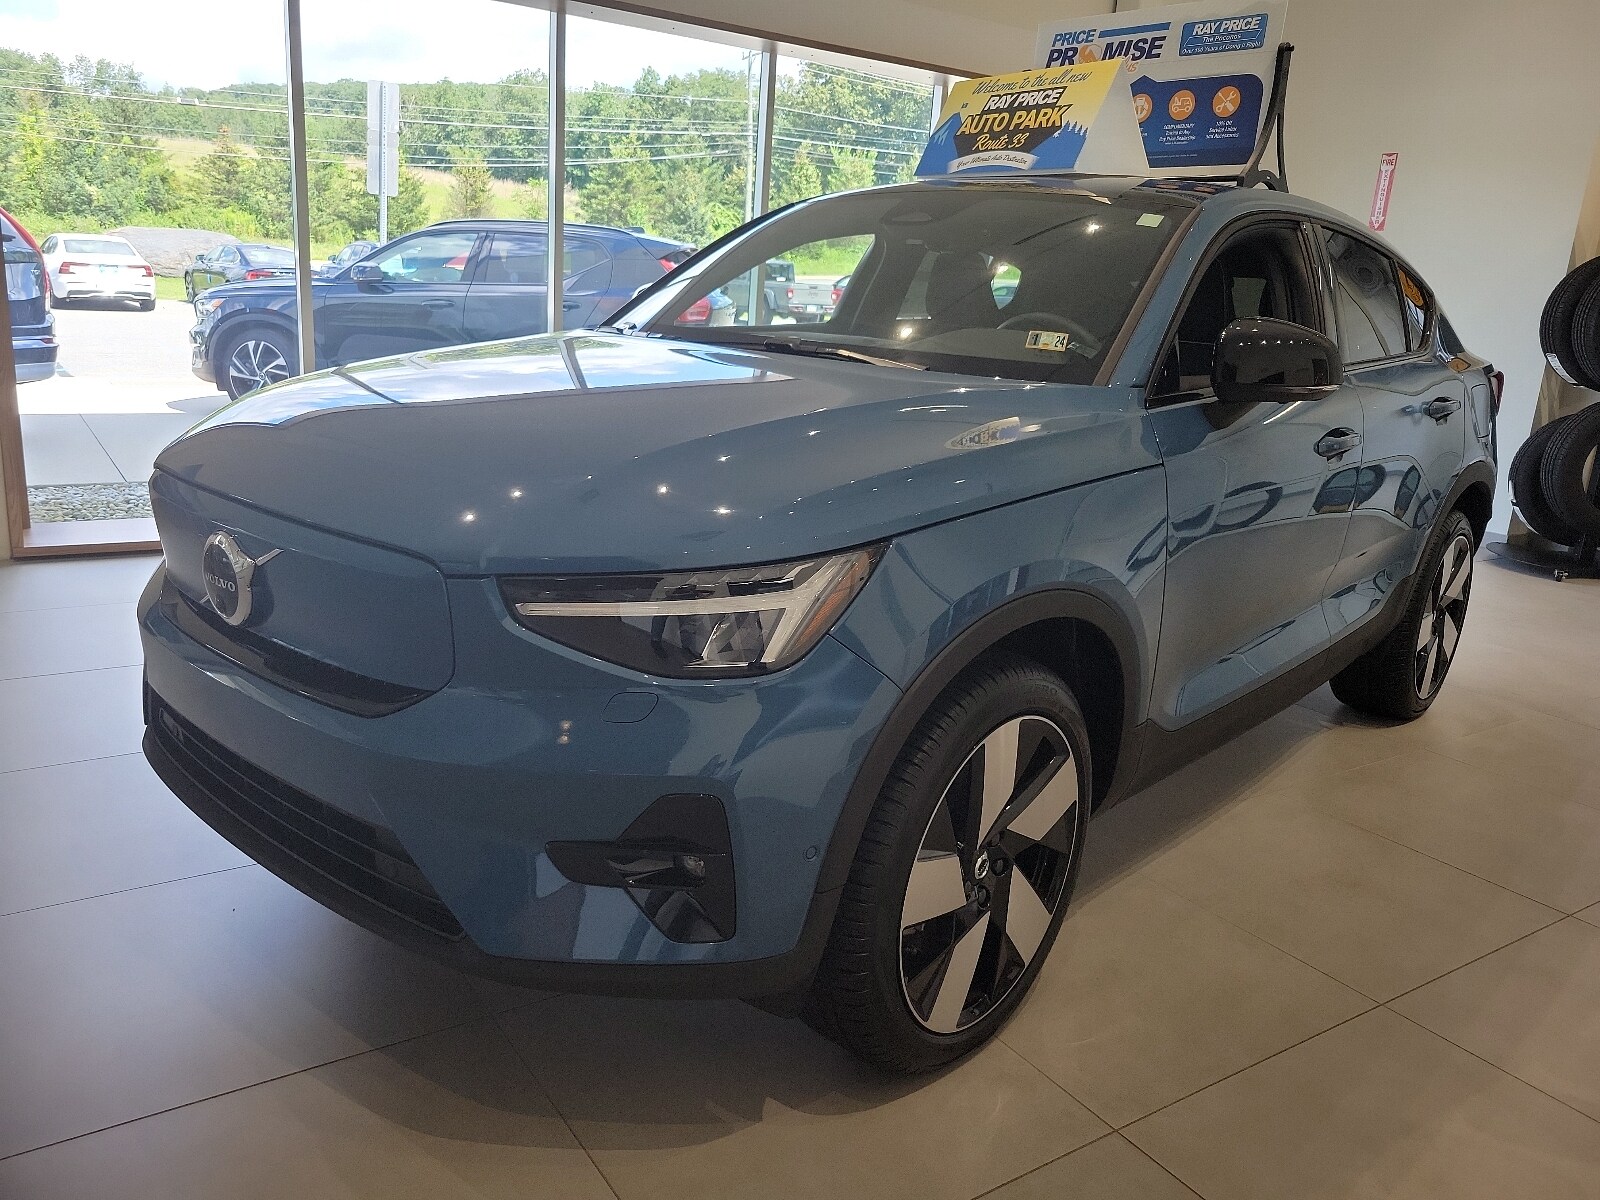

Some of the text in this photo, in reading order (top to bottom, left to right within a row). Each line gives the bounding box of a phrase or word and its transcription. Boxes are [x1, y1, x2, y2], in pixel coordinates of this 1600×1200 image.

[1193, 16, 1261, 36] RAY PRICE
[1051, 28, 1098, 47] PRICE
[972, 68, 1093, 96] Welcome to the all new
[984, 88, 1065, 111] RAY PRICE
[956, 105, 1070, 136] AUTO PARK
[972, 131, 1030, 152] Route 33
[1382, 158, 1395, 166] FIRE
[1054, 335, 1066, 348] 24
[205, 572, 236, 592] VOLVO
